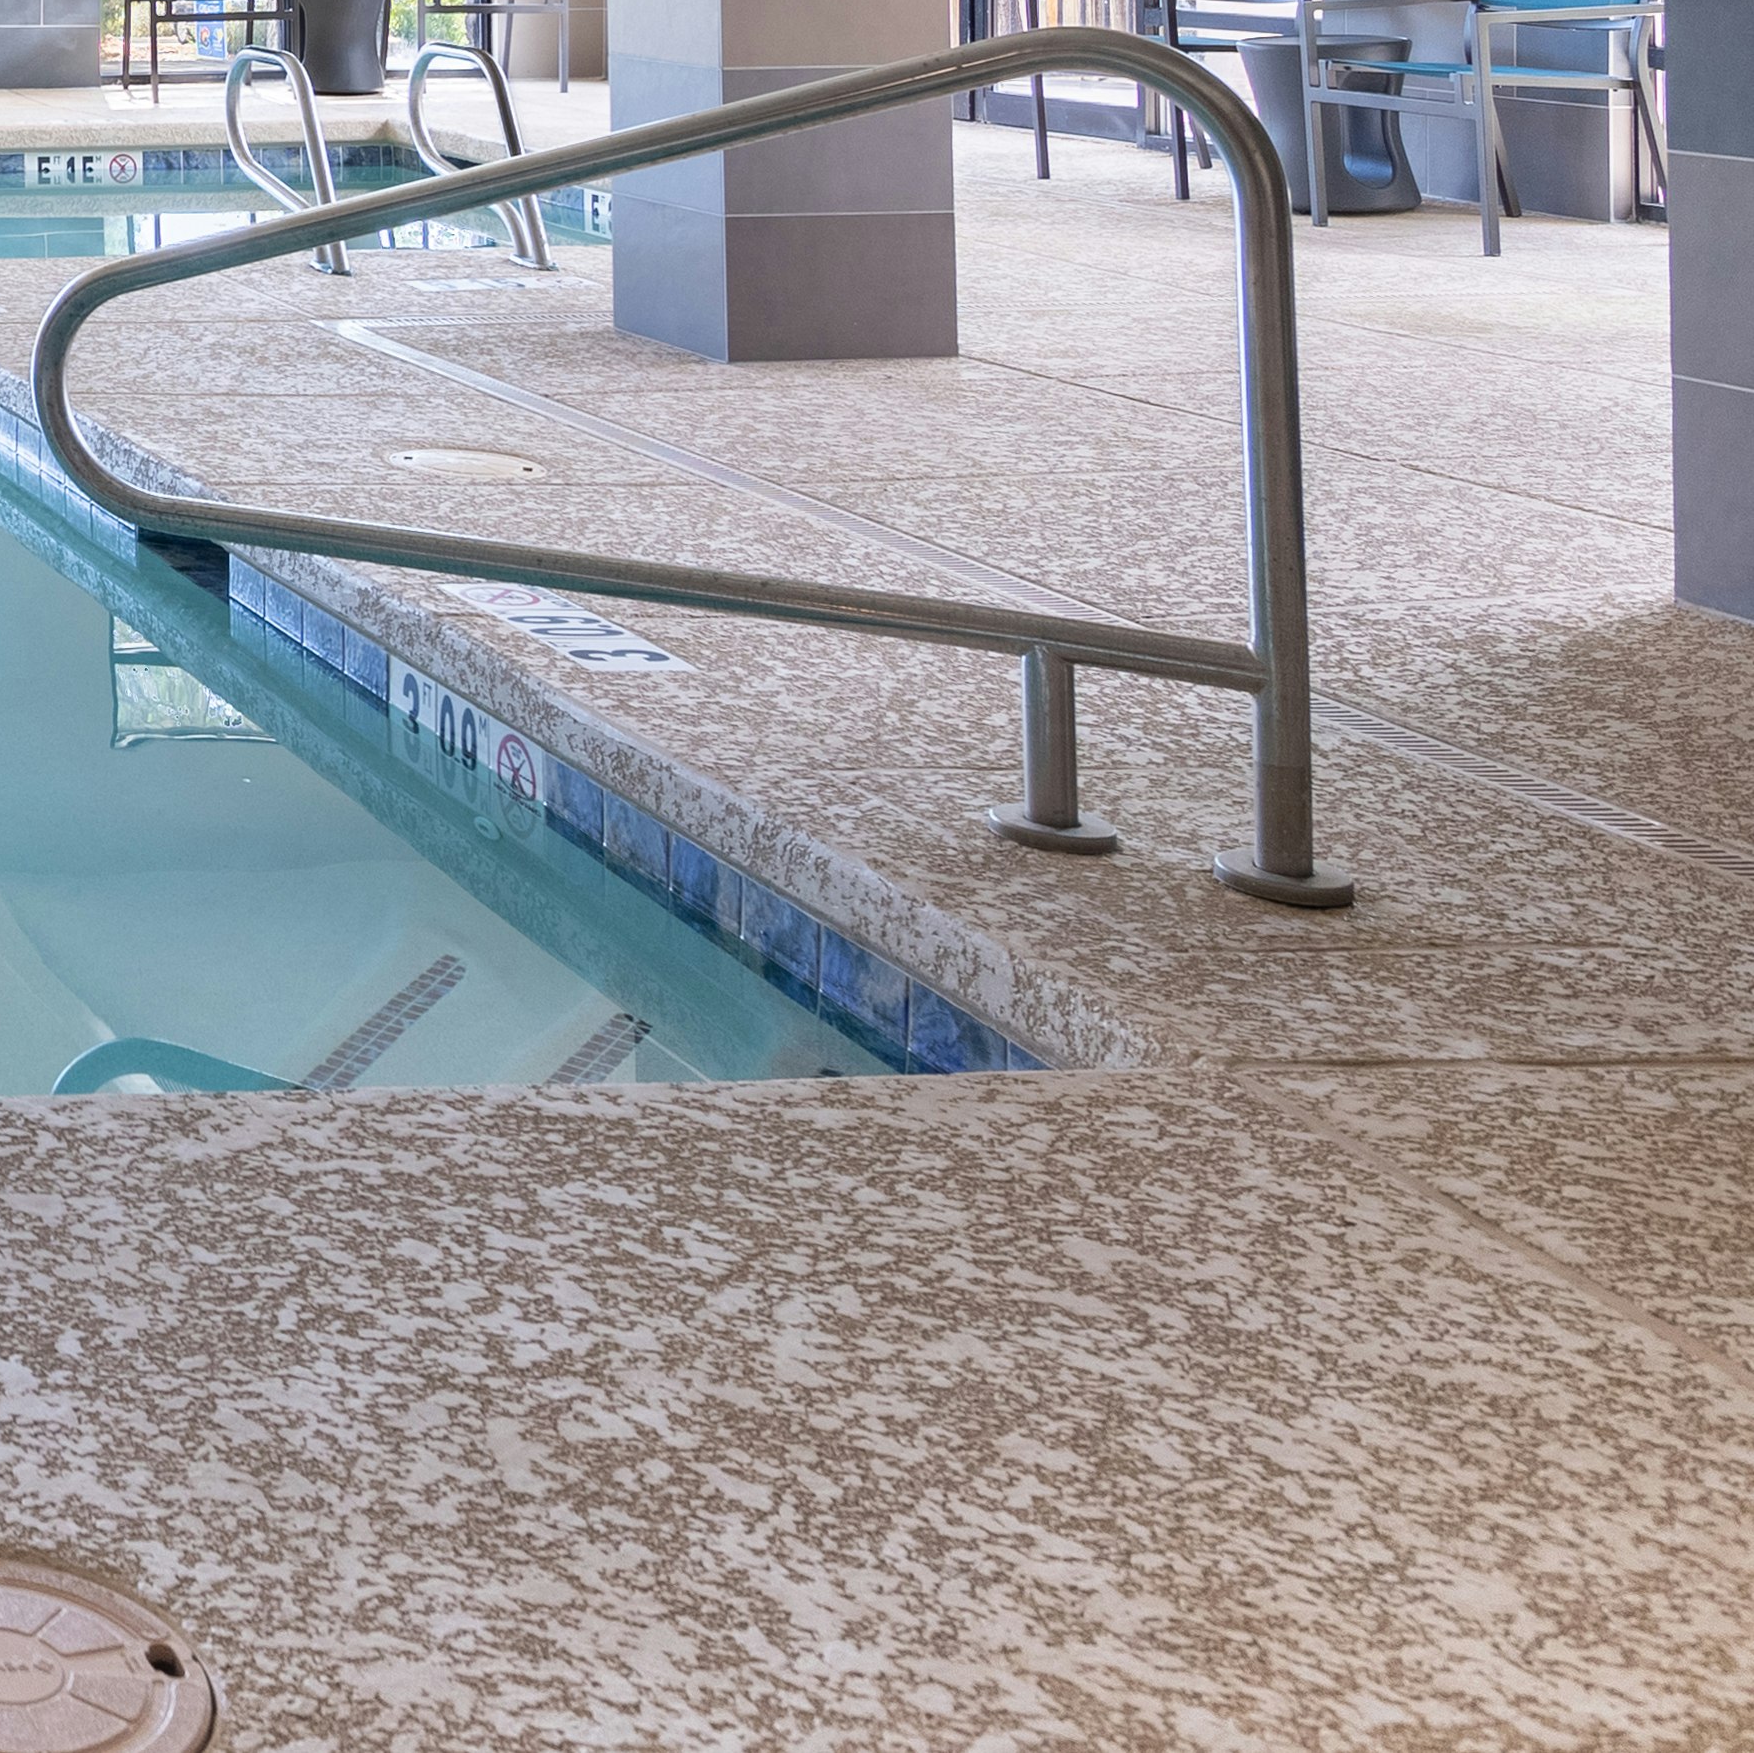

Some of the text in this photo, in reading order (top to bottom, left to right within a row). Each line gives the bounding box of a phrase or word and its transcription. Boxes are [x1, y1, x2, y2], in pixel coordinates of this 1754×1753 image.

[402, 673, 420, 734] 3
[423, 682, 432, 709] FT
[479, 716, 488, 738] M
